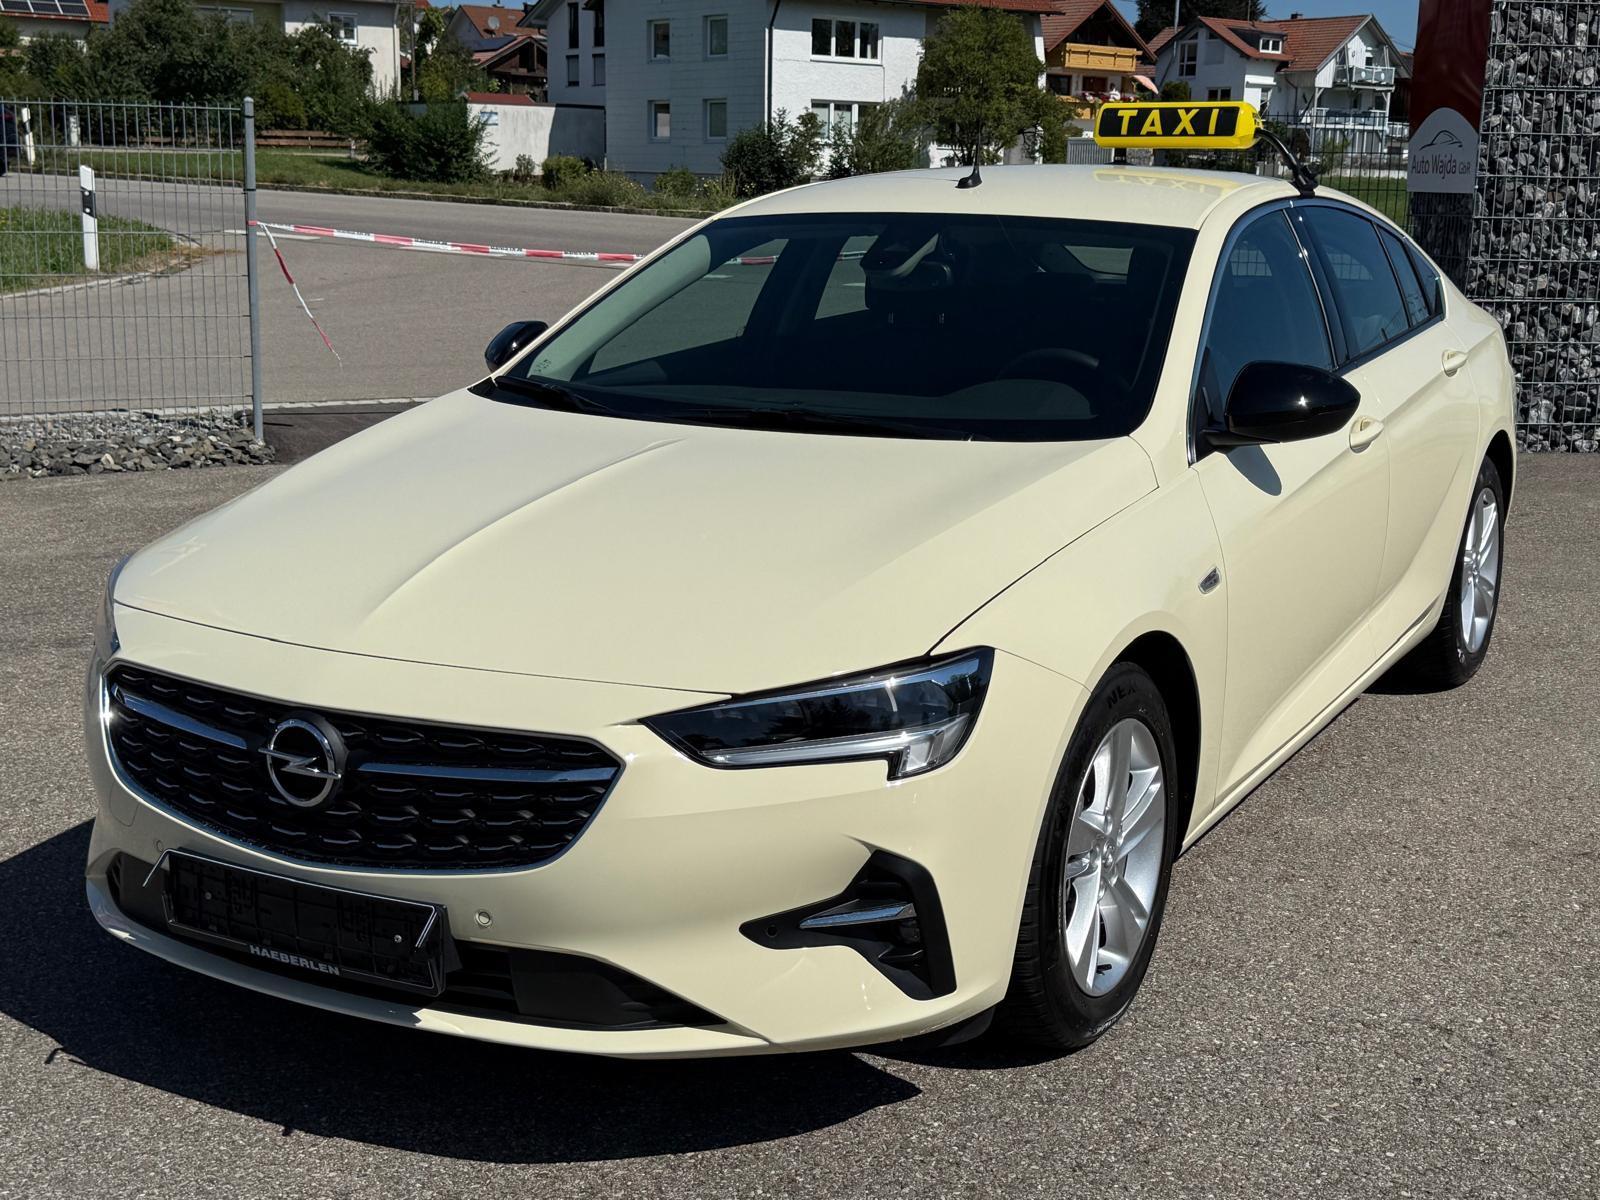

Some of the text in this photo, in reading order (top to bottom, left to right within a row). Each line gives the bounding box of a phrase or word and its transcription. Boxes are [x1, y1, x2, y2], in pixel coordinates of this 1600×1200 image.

[1117, 108, 1220, 136] TAXI
[1411, 154, 1430, 175] Auto
[1431, 153, 1457, 180] Wajda
[249, 944, 340, 977] HAEBERLEN
